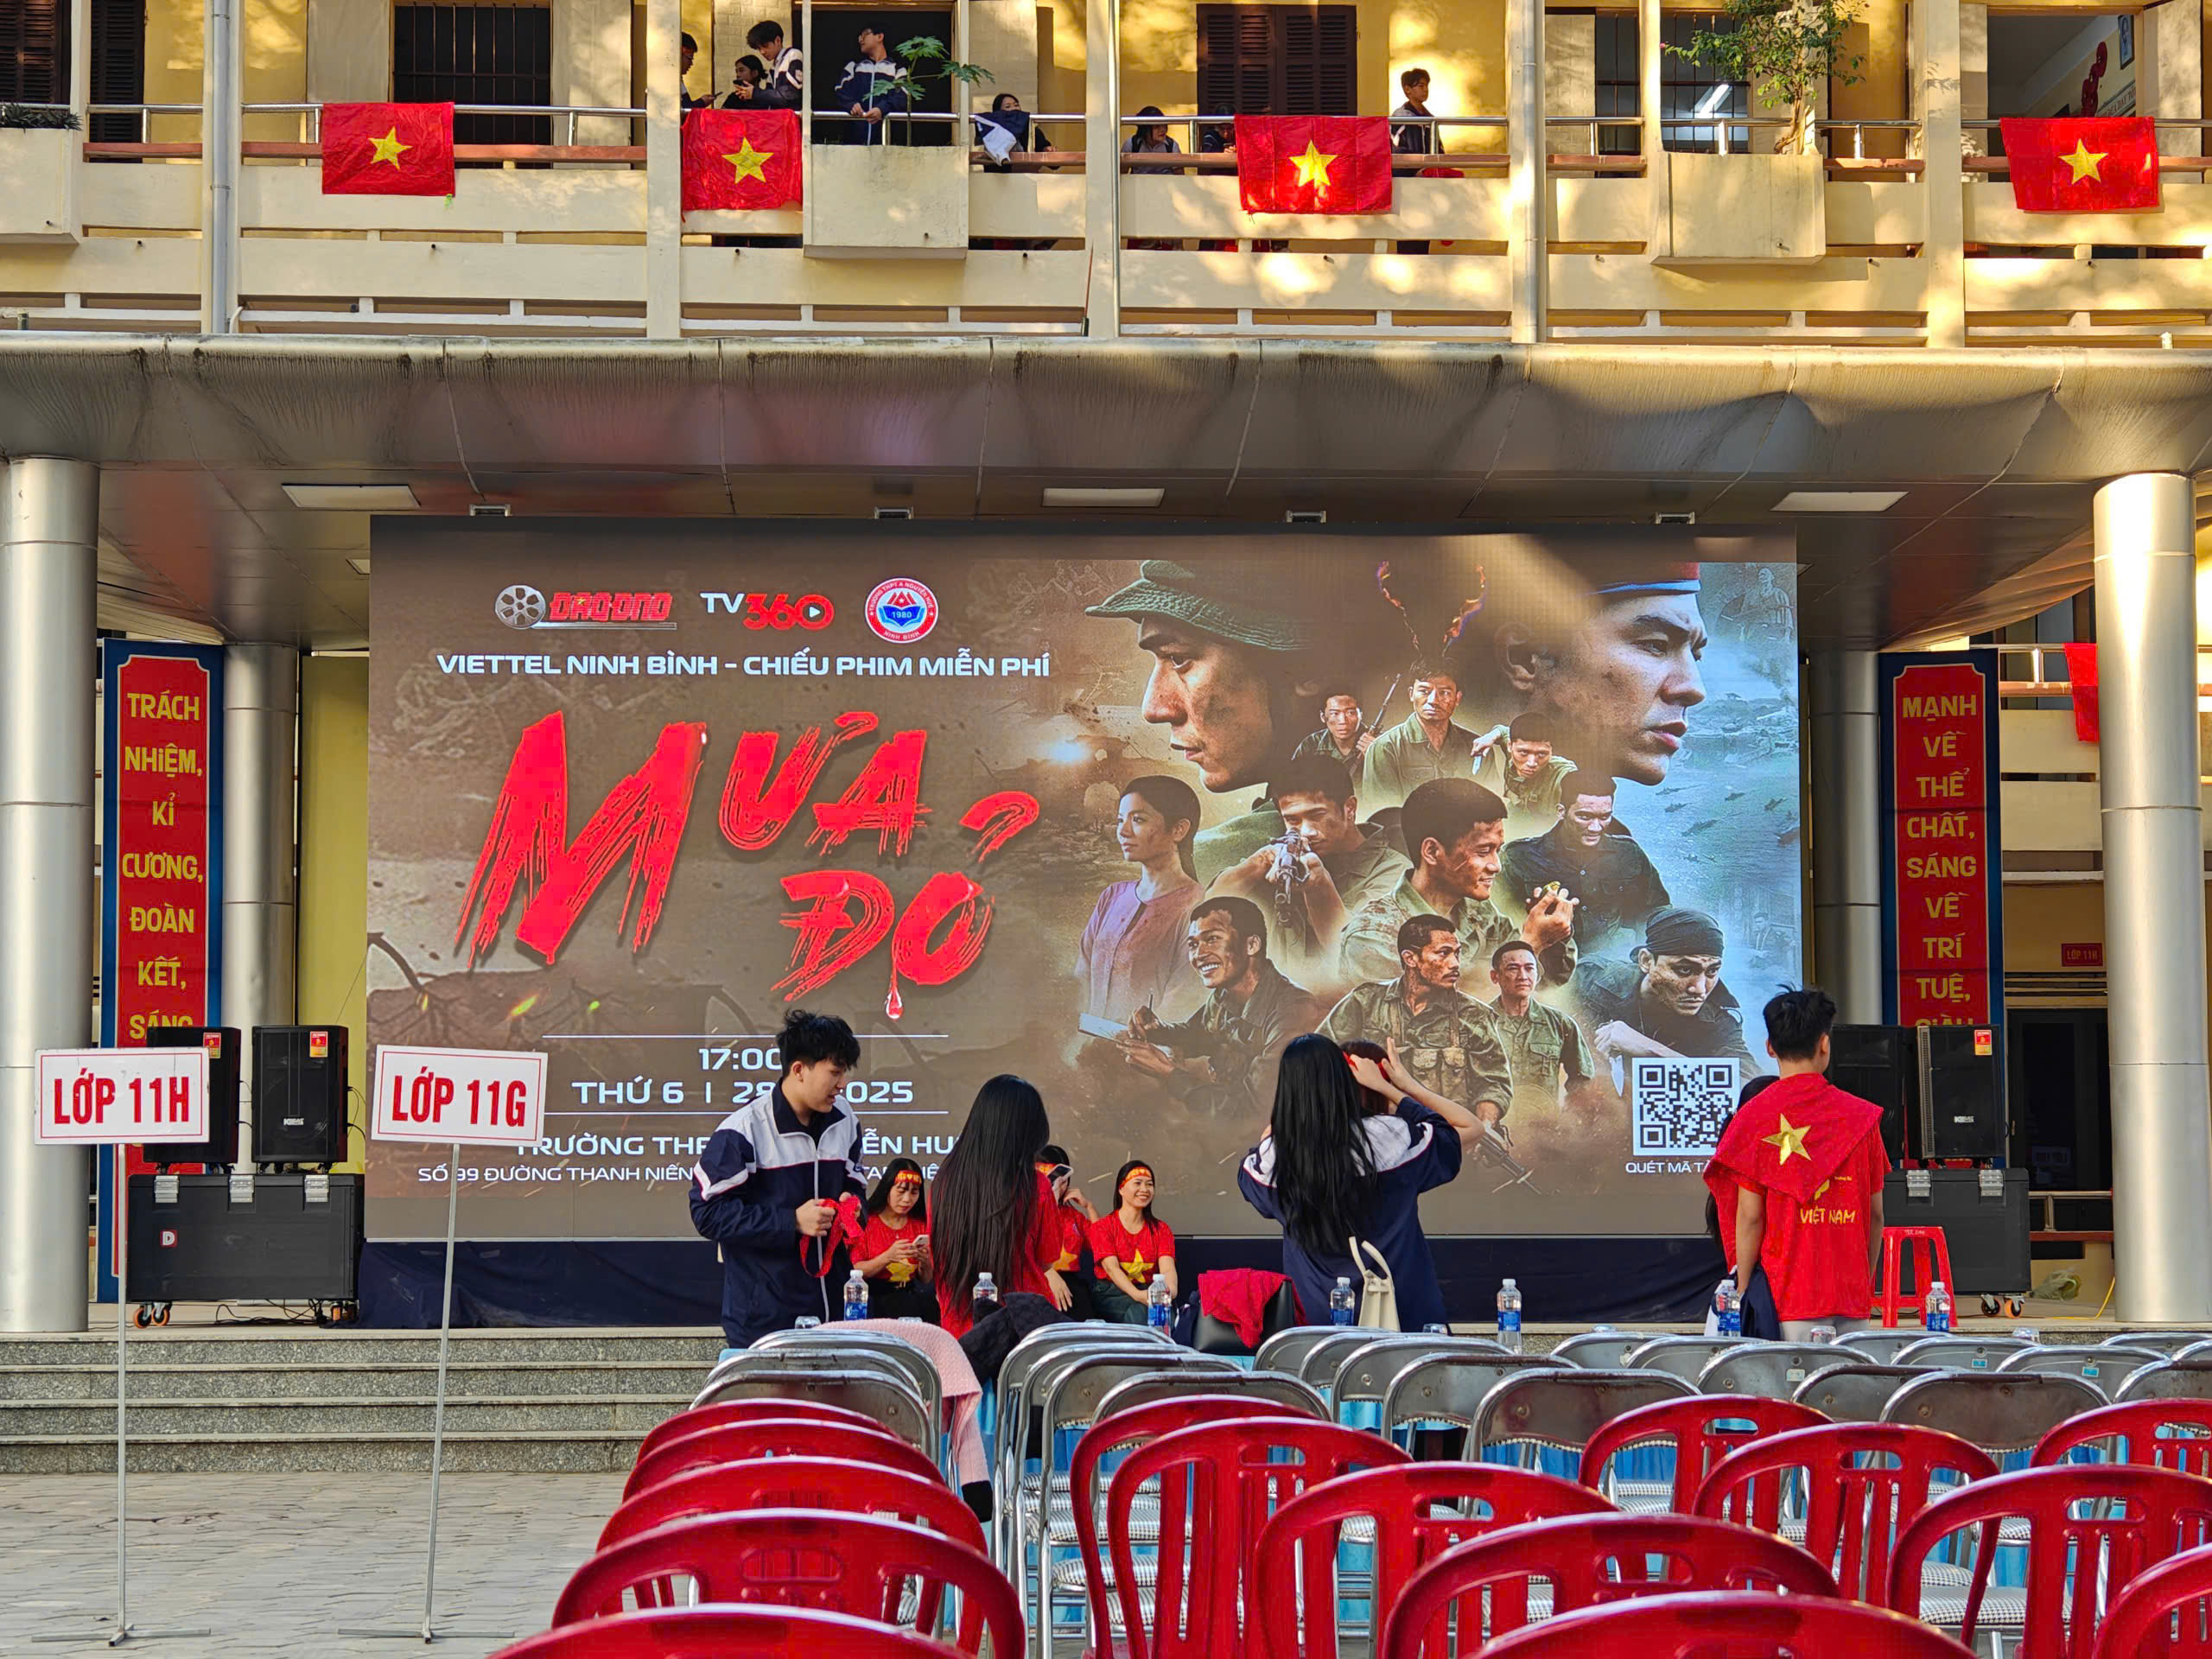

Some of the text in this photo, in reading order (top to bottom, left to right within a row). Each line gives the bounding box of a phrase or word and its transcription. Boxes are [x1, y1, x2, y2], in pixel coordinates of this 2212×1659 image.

[891, 611, 912, 620] 1980
[436, 654, 562, 675] VIETTEL
[567, 655, 639, 675] NINH
[646, 650, 718, 675] BÌNH
[743, 646, 830, 676] CHIẾU
[836, 656, 912, 677] PHIM
[918, 647, 995, 677] MIỄN
[1001, 652, 1051, 677] PHÍ
[126, 690, 200, 721] TRÁCH
[1902, 694, 1977, 721] MẠNH
[1923, 730, 1967, 758] VỀ
[124, 742, 203, 778] NHIỆM,
[1916, 767, 1970, 798] THỂ
[151, 791, 175, 826] KỈ
[454, 710, 932, 968] MƯA
[1906, 811, 1975, 840] CHẤT,
[122, 851, 204, 883] CƯƠNG,
[1906, 851, 1977, 879] SÁNG
[130, 902, 194, 933] ĐOÀN
[771, 791, 1039, 1020] ĐỎ
[1924, 892, 1970, 918] VỀ
[1923, 931, 1967, 959] TRÍ
[137, 955, 188, 990] KẾT,
[1916, 973, 1971, 1003] TUỆ,
[698, 1047, 783, 1071] 17:00
[53, 1067, 190, 1125] LỚP 11H
[391, 1066, 527, 1128] LỚP 11G
[570, 1075, 653, 1104] THỨ
[662, 1082, 685, 1104] 6
[912, 1135, 959, 1154] HU
[417, 1163, 448, 1181] SỐ
[483, 1164, 562, 1181] ĐƯỜNG
[566, 1166, 639, 1181] THANH
[645, 1163, 694, 1181] NIÊN
[1625, 1160, 1665, 1173] QUÉT
[1668, 1160, 1692, 1173] MÃ
[1799, 1205, 1856, 1225] VIỆT NAM
